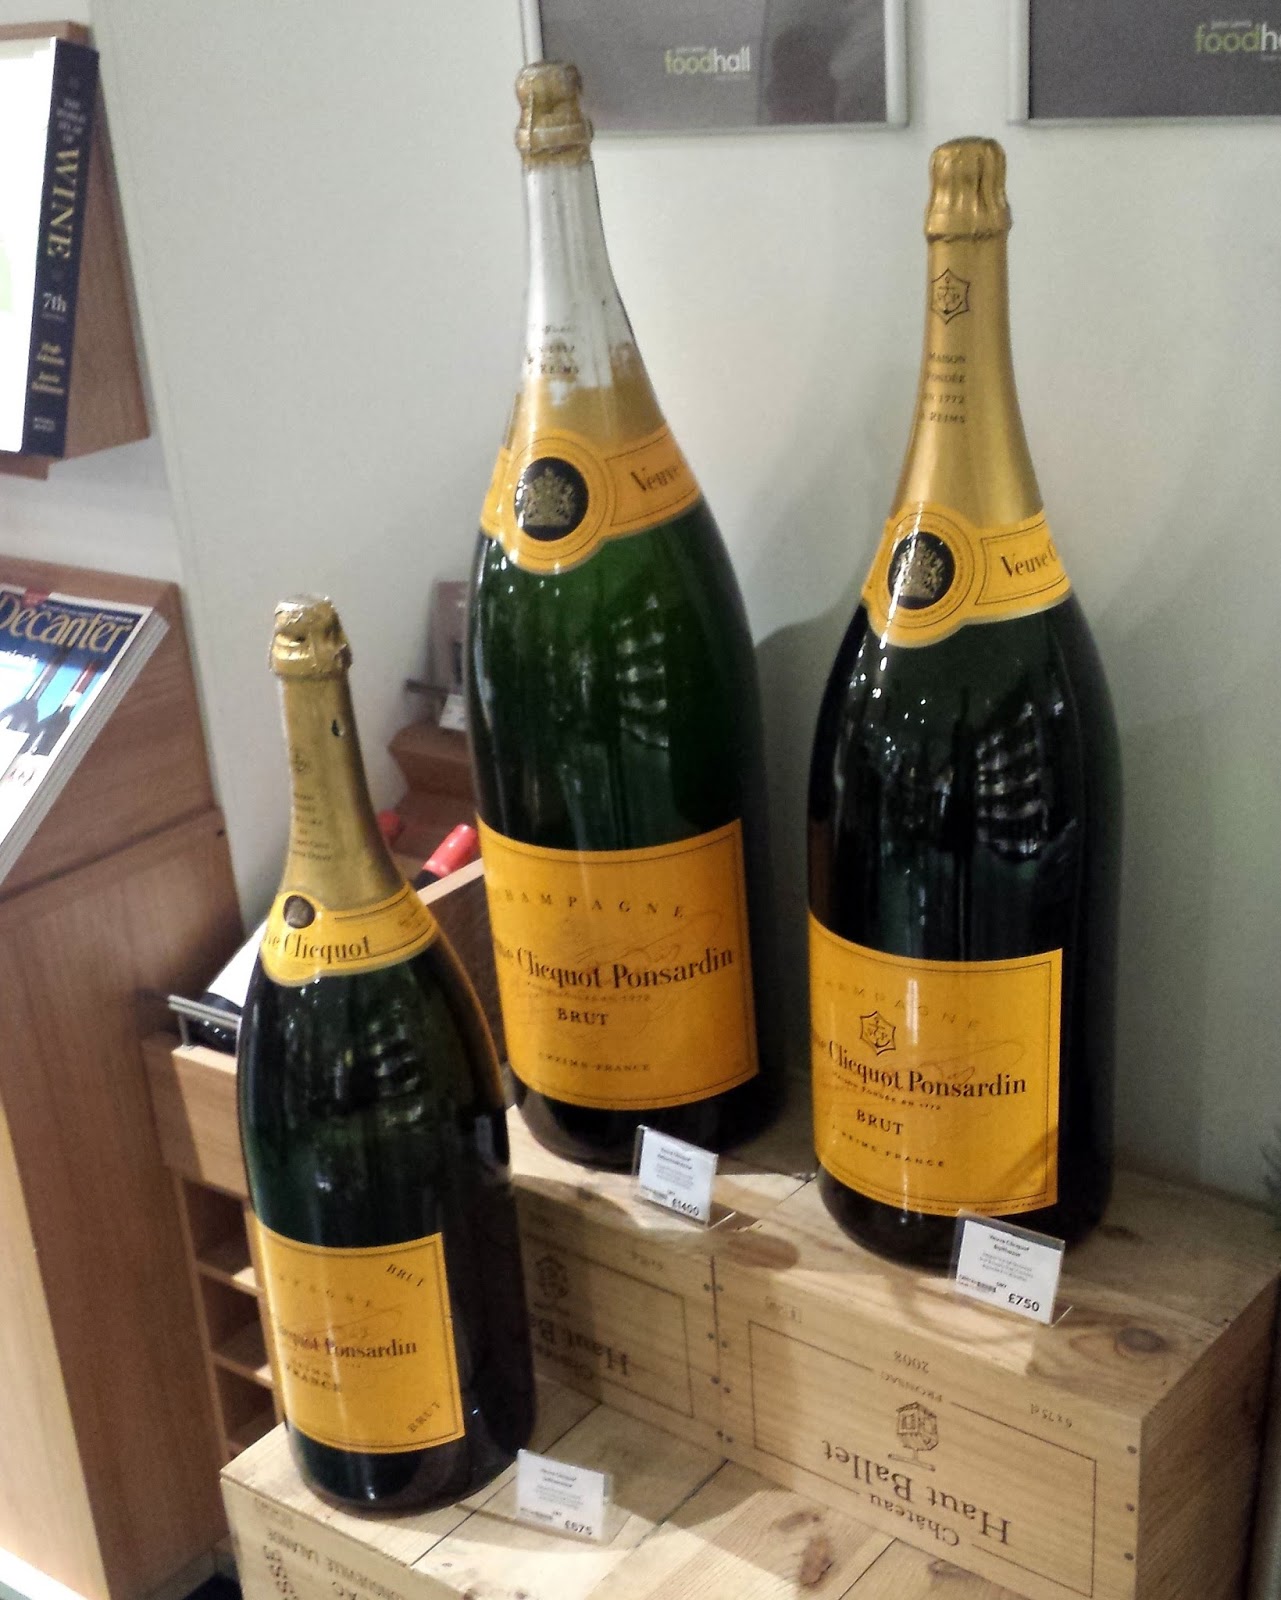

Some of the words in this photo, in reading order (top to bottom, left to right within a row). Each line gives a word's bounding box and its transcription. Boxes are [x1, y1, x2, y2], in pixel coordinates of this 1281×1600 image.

[1195, 21, 1281, 53] foodh
[664, 45, 751, 74] foodhall
[48, 149, 80, 259] WINE
[630, 464, 681, 493] Veuv
[1000, 552, 1049, 578] Veuve
[0, 592, 137, 654] Decanter
[283, 932, 371, 965] Clicquot
[517, 946, 604, 989] Clicquot
[613, 946, 733, 989] Ponsardin
[557, 1007, 608, 1026] BRUT
[828, 1039, 904, 1089] Clicquot
[908, 1070, 1027, 1098] Ponsardin
[856, 1108, 905, 1136] BRUT
[1008, 1293, 1041, 1312] £750
[323, 1337, 418, 1358] Ponsardin
[407, 1401, 440, 1433] BRUT
[822, 1439, 913, 1504] Ballet
[868, 1492, 960, 1546] Château
[926, 1486, 1011, 1545] Haut
